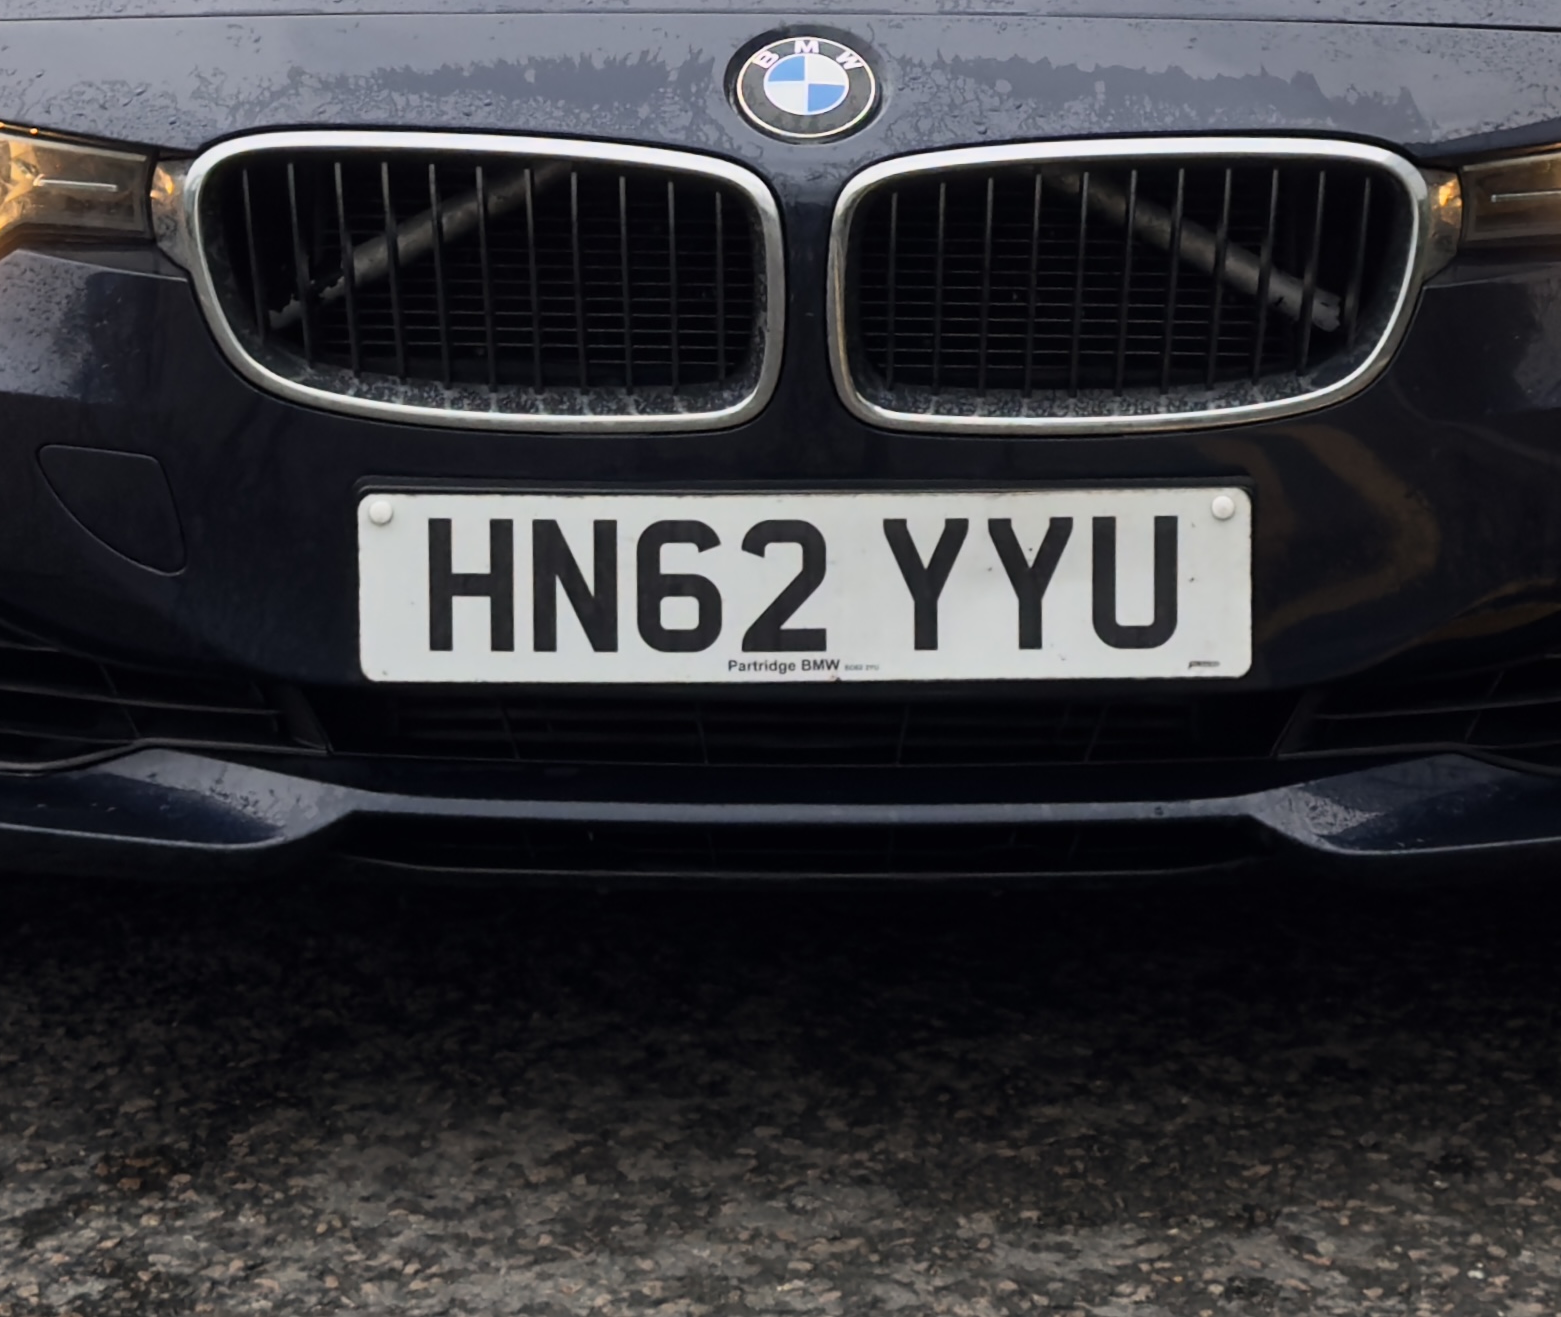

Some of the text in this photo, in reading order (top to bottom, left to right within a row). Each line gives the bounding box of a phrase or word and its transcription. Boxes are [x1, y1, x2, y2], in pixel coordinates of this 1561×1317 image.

[752, 40, 865, 70] BMW
[429, 516, 1179, 652] HN62 YYU
[728, 660, 796, 674] Partridge
[801, 659, 840, 672] BMW
